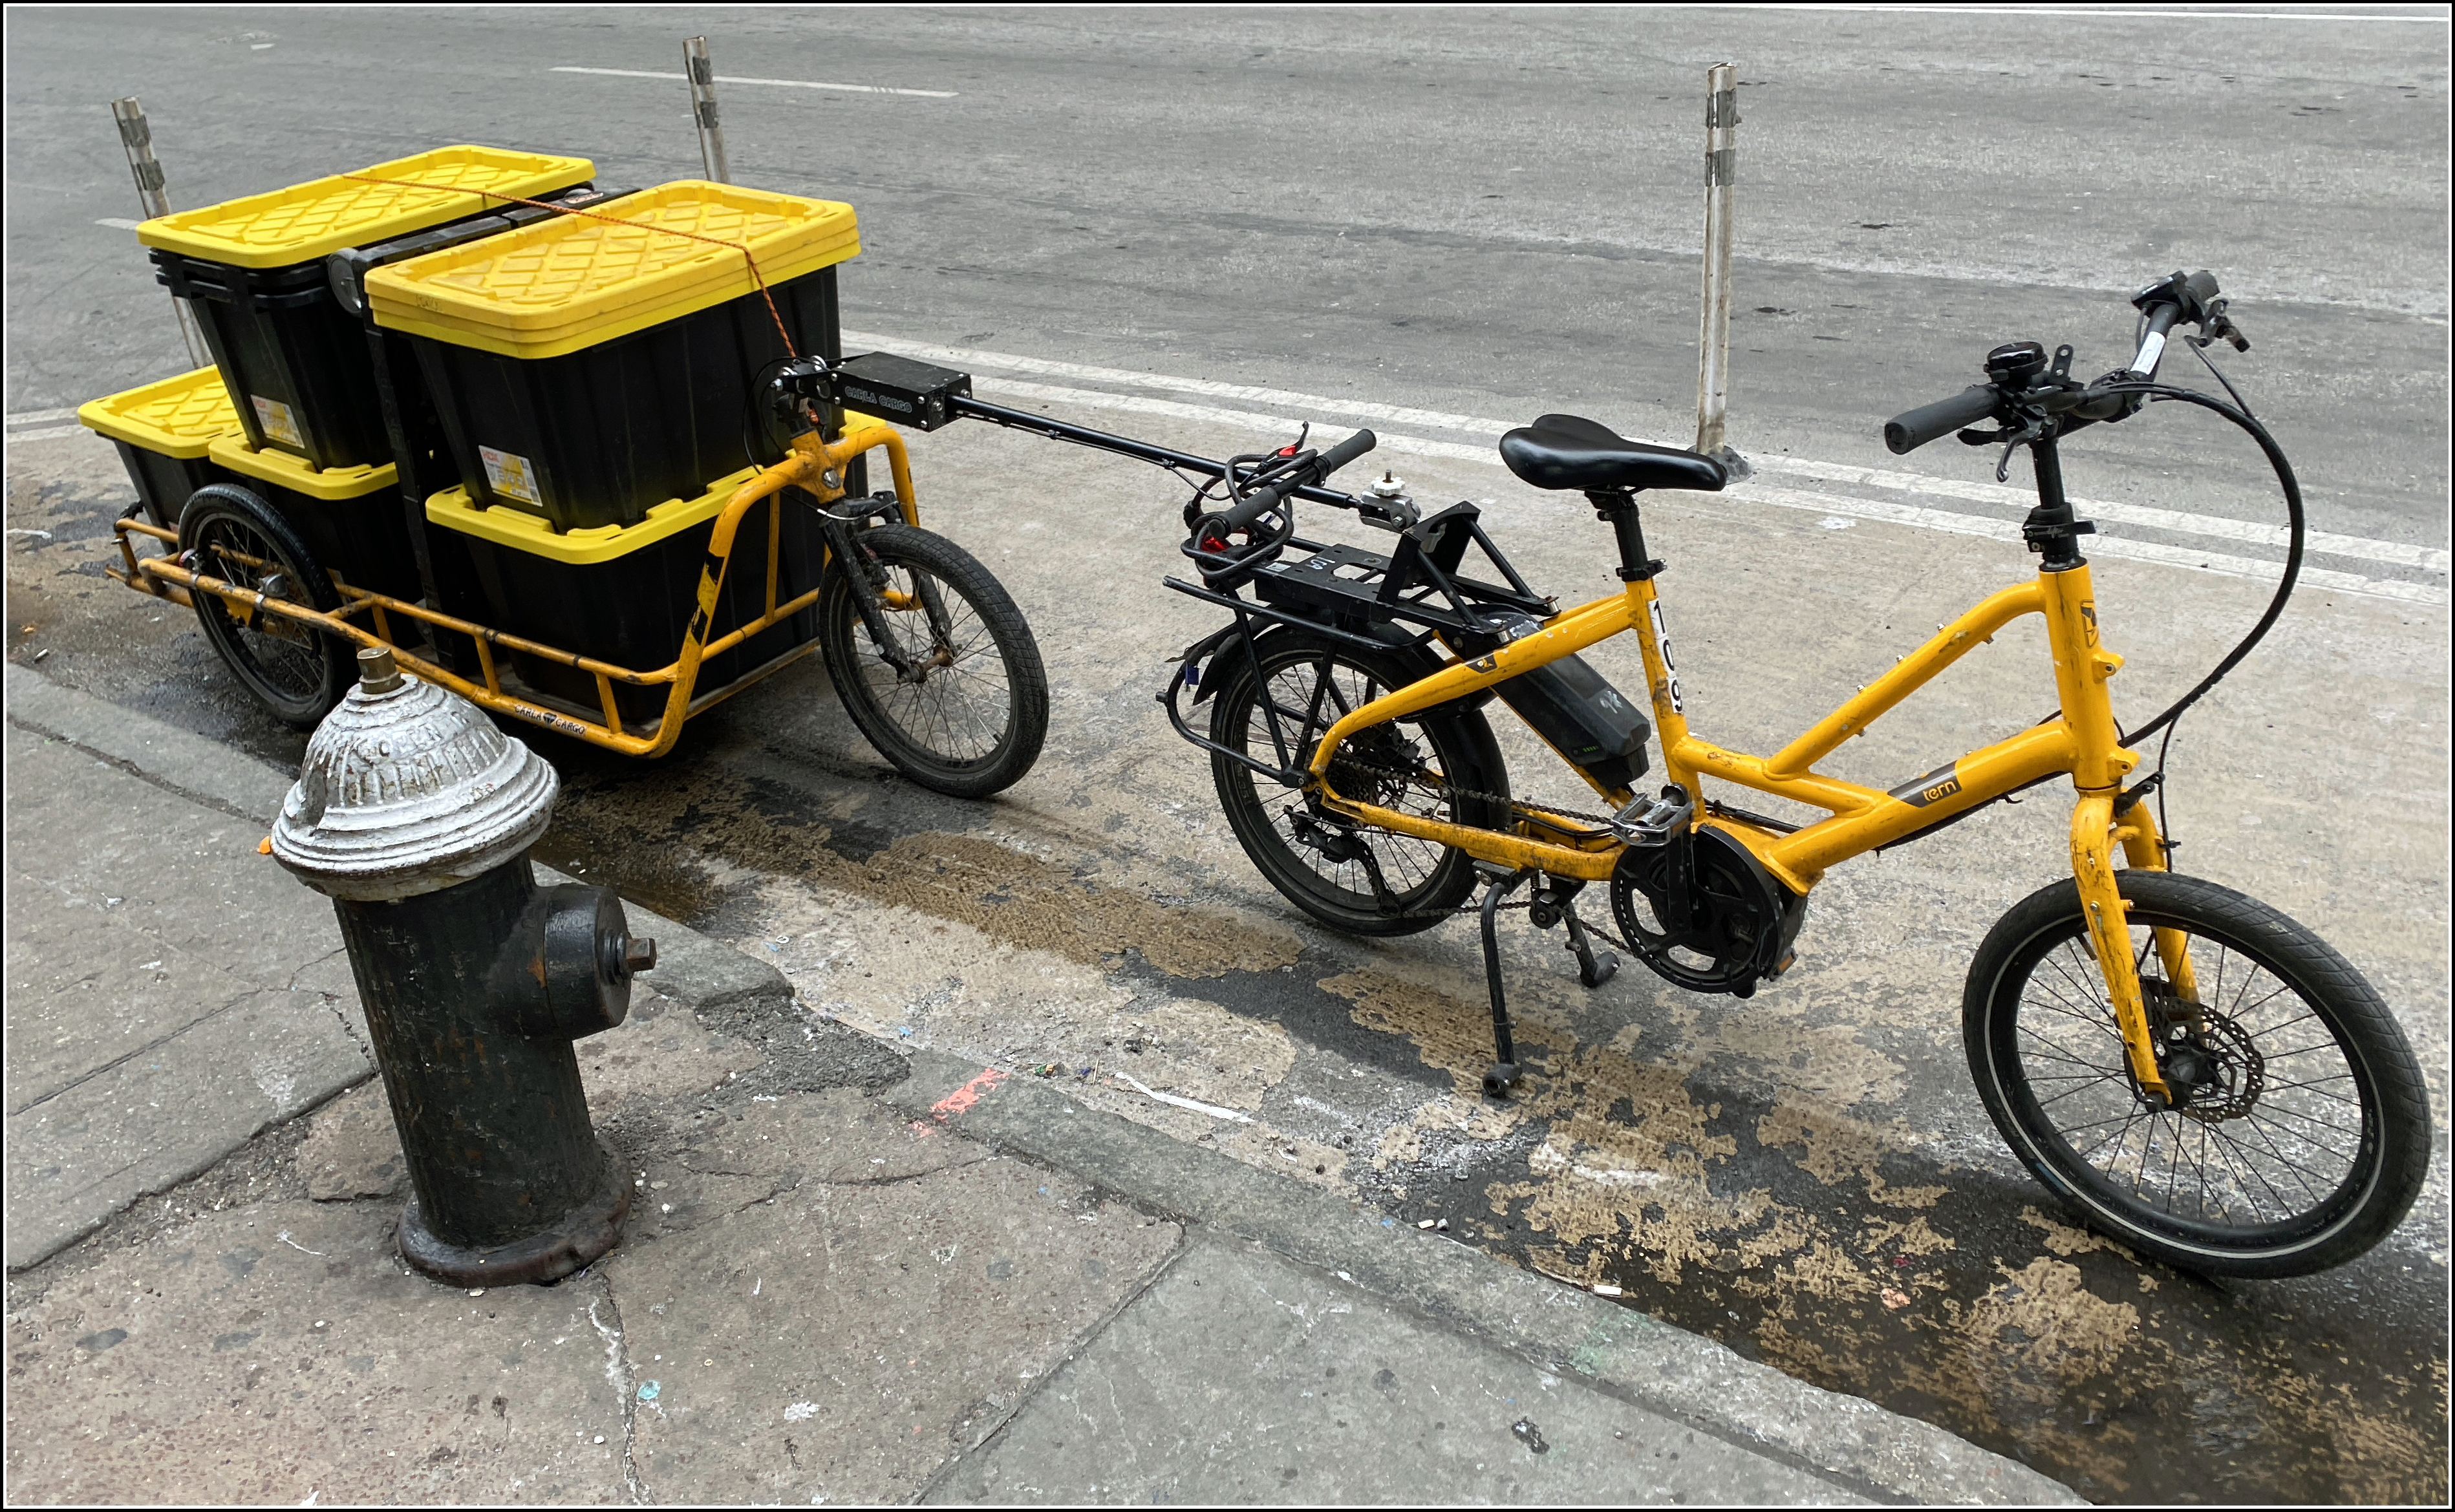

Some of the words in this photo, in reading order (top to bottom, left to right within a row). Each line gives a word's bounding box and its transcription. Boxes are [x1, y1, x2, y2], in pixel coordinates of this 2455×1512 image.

[844, 386, 877, 404] CARLA
[879, 395, 912, 413] CARGO
[1653, 600, 1683, 712] 109
[515, 704, 542, 720] CARLA
[555, 718, 585, 734] CARGO
[1923, 781, 1956, 802] tern
